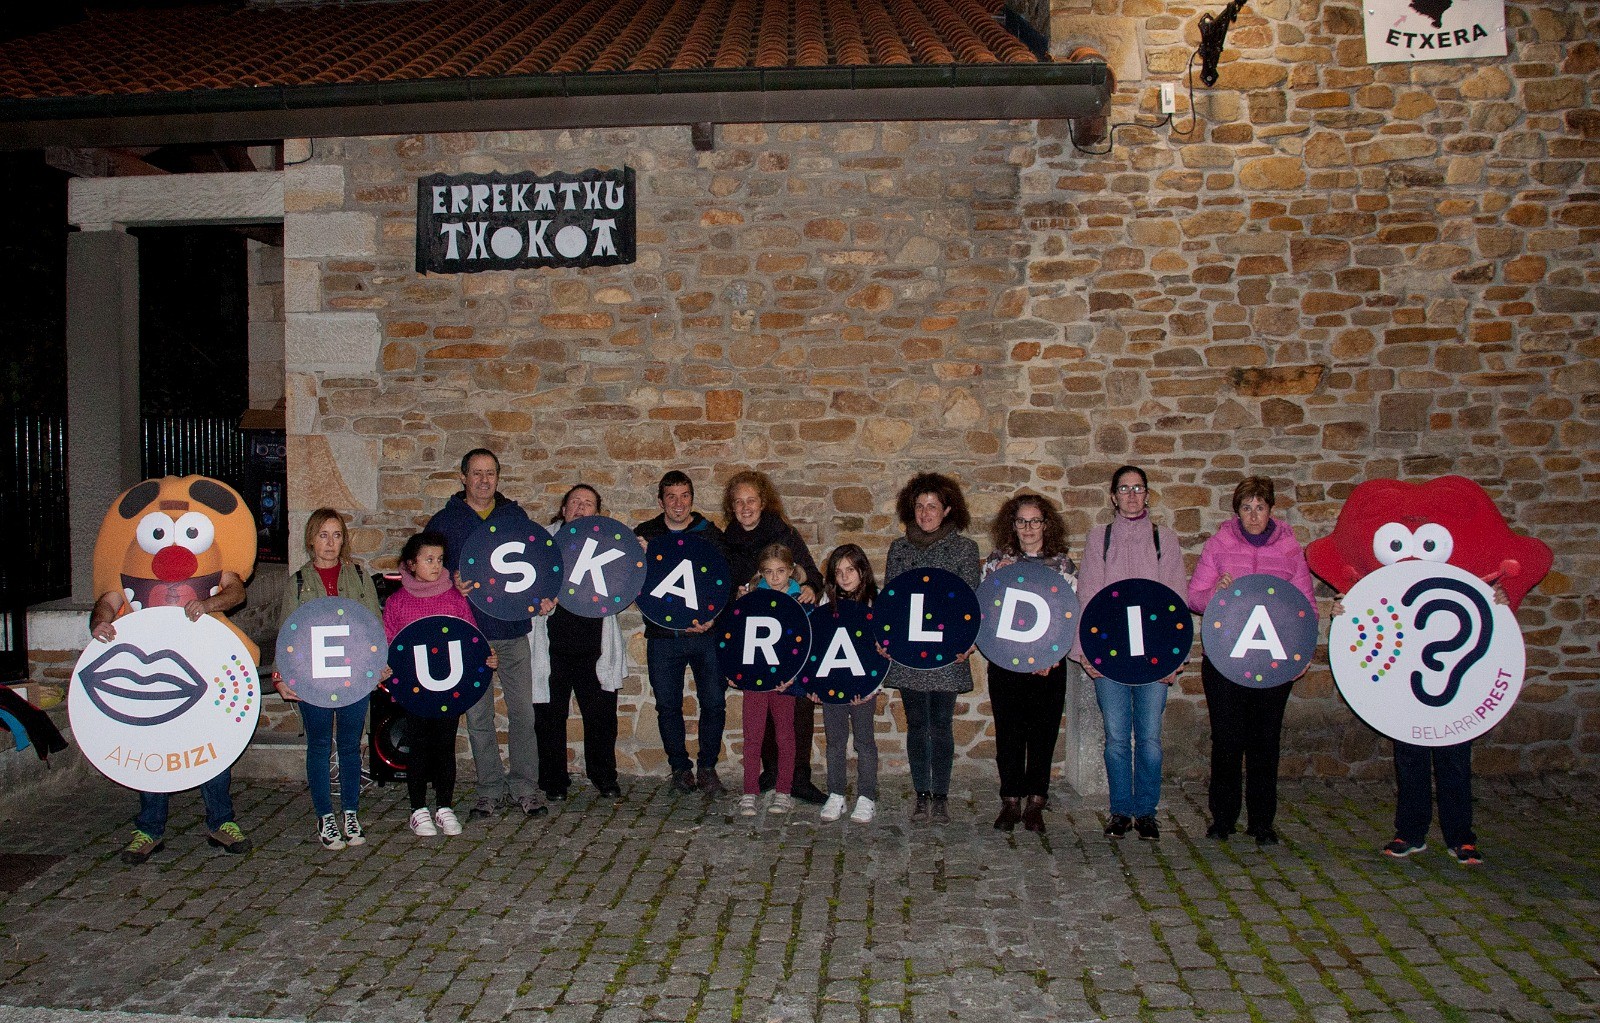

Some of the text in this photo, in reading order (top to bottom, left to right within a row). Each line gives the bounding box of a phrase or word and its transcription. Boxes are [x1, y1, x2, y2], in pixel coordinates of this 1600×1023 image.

[1385, 24, 1488, 49] ETXERA
[440, 218, 618, 260] TXOKOA
[490, 541, 537, 593] S
[569, 537, 626, 597] K
[650, 558, 699, 611] A
[742, 616, 781, 665] R
[908, 593, 943, 643] L
[996, 587, 1051, 643] D
[1127, 605, 1145, 657] I
[1230, 604, 1288, 660] A
[311, 625, 351, 678] E
[413, 640, 464, 692] U
[816, 627, 866, 678] A
[1411, 668, 1512, 740] BELARRIPREST
[104, 742, 218, 772] AHOBIZI
